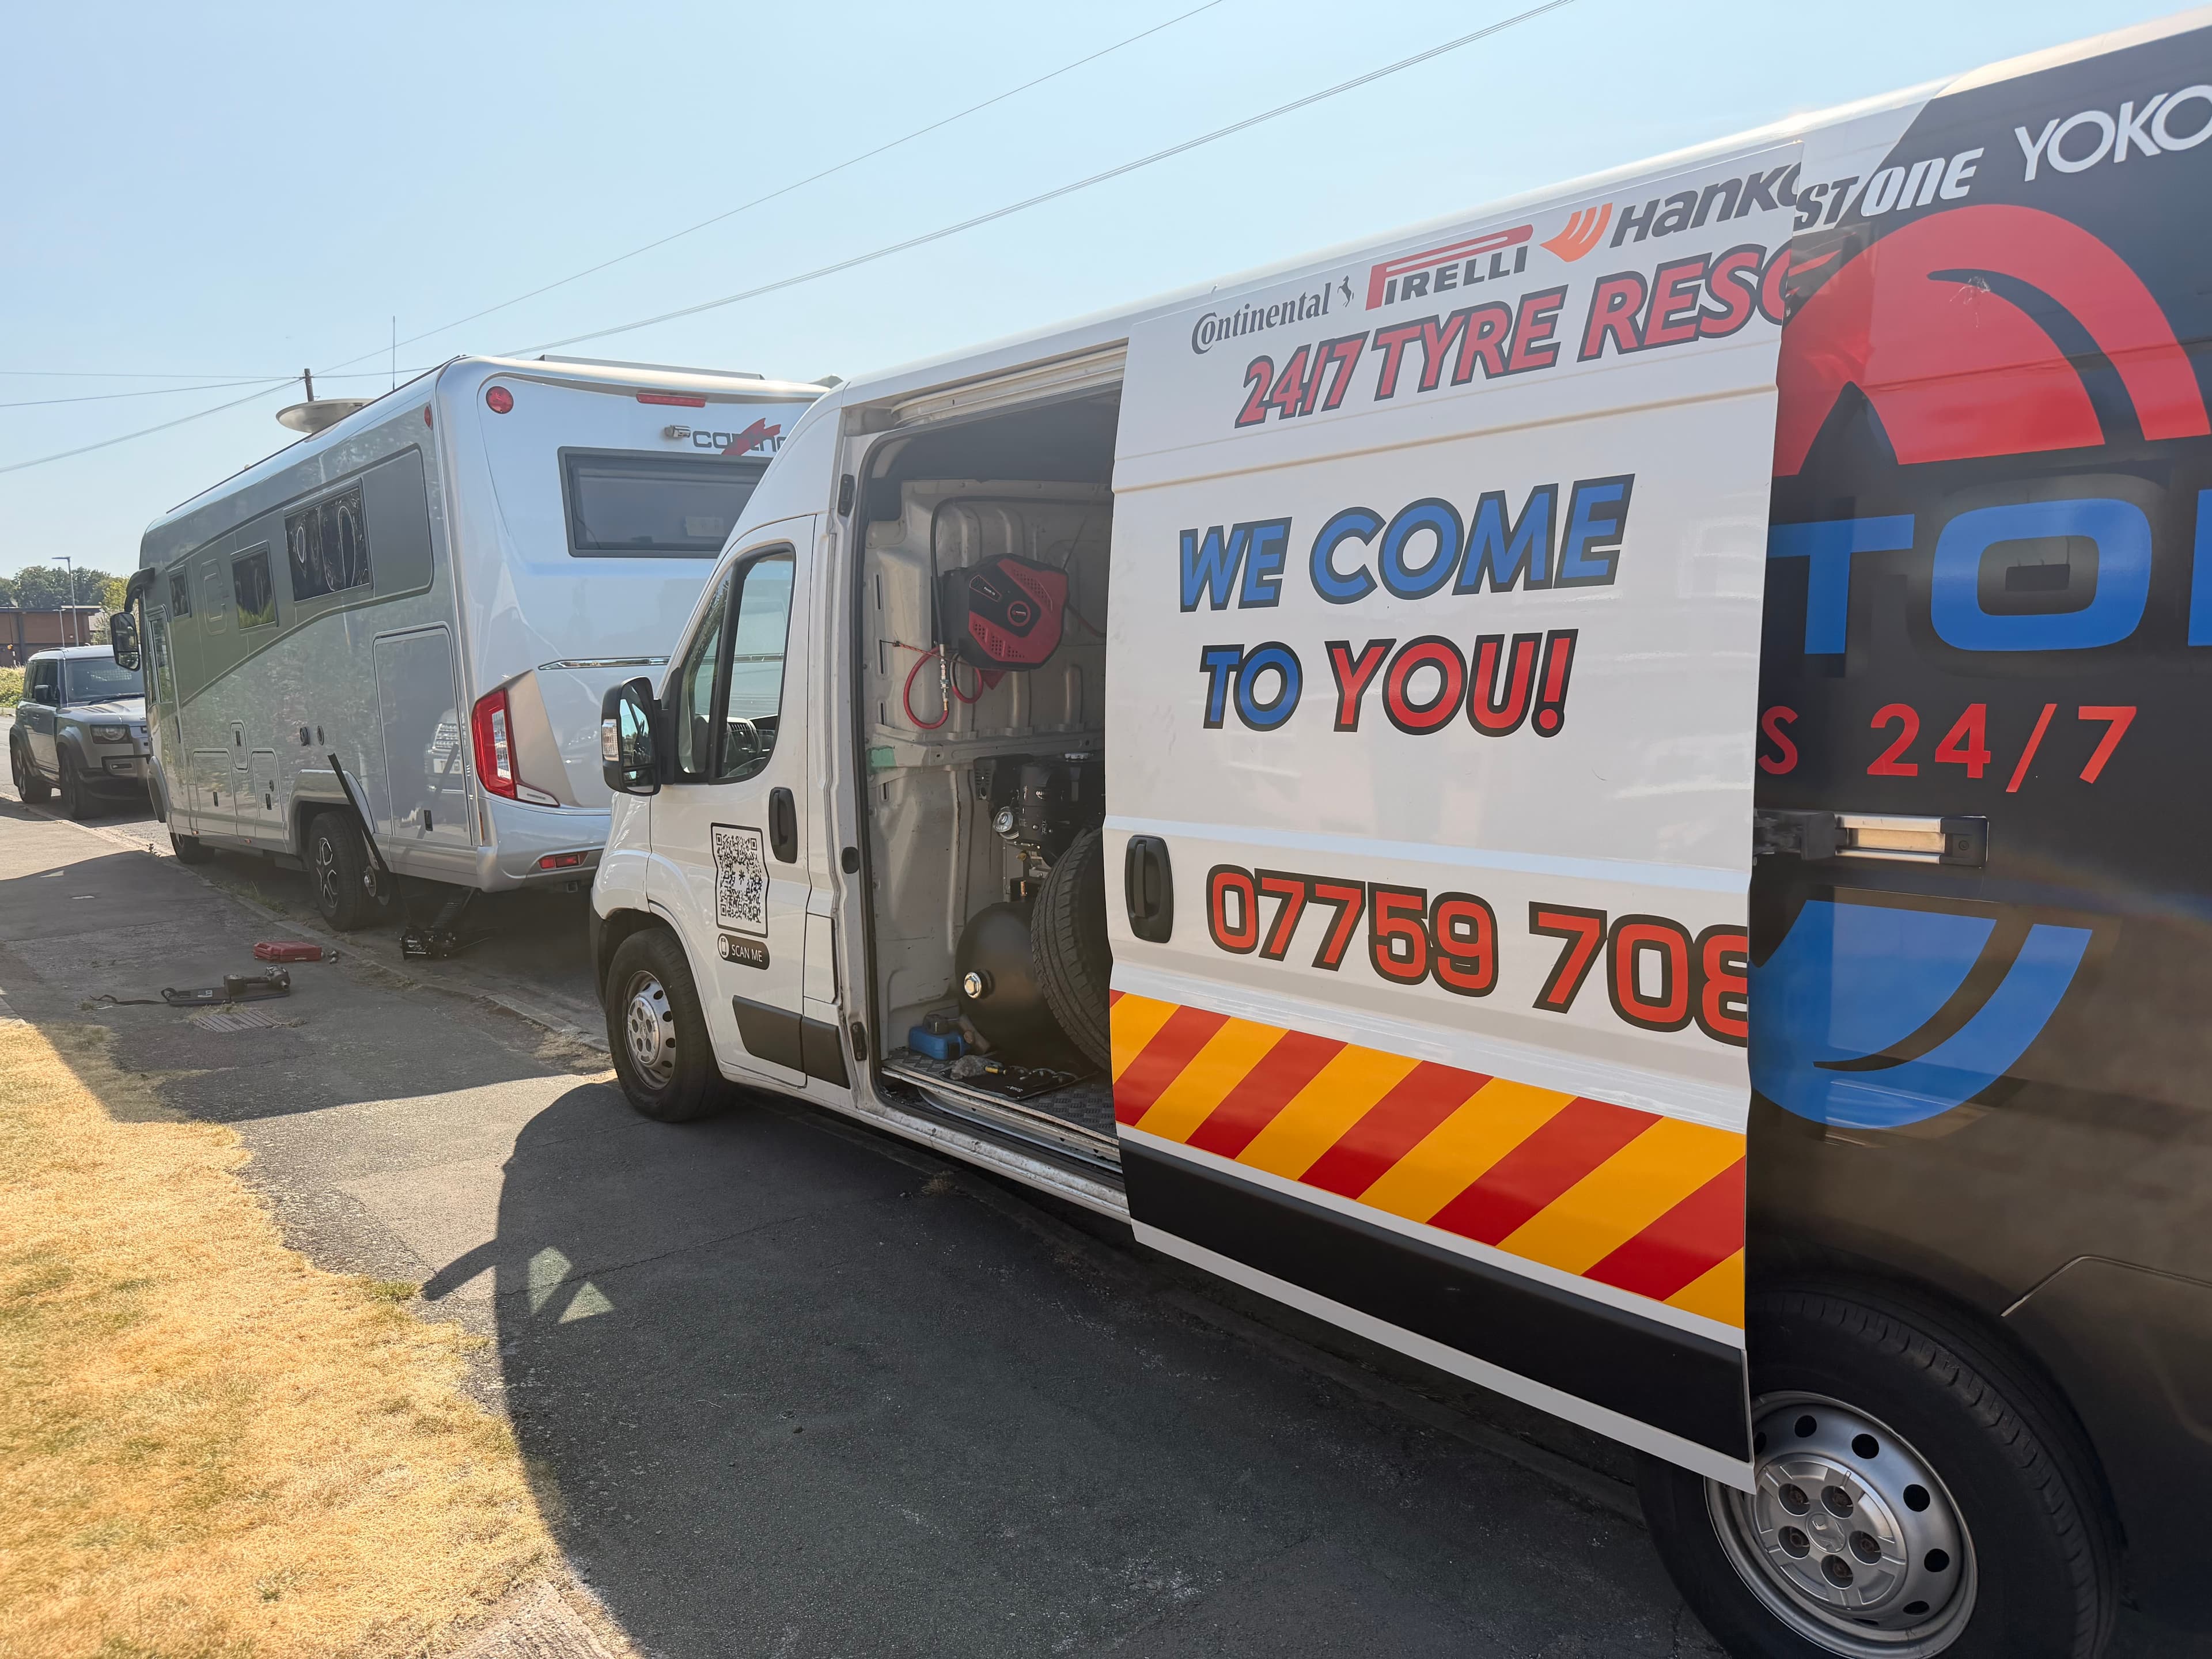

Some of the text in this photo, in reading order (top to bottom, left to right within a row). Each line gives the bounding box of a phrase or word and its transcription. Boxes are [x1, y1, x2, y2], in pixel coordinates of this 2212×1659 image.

[1365, 224, 1533, 311] PIRELLI
[1191, 282, 1331, 355] Continental
[1233, 330, 1370, 429] 24/7
[1373, 284, 1569, 402] TYRE
[1179, 472, 1635, 612] WE COME
[1200, 628, 1579, 737] TO YOU!
[1866, 703, 2137, 793] 24/7
[731, 944, 763, 963] SCAN ME
[1206, 863, 1499, 998] 07759
